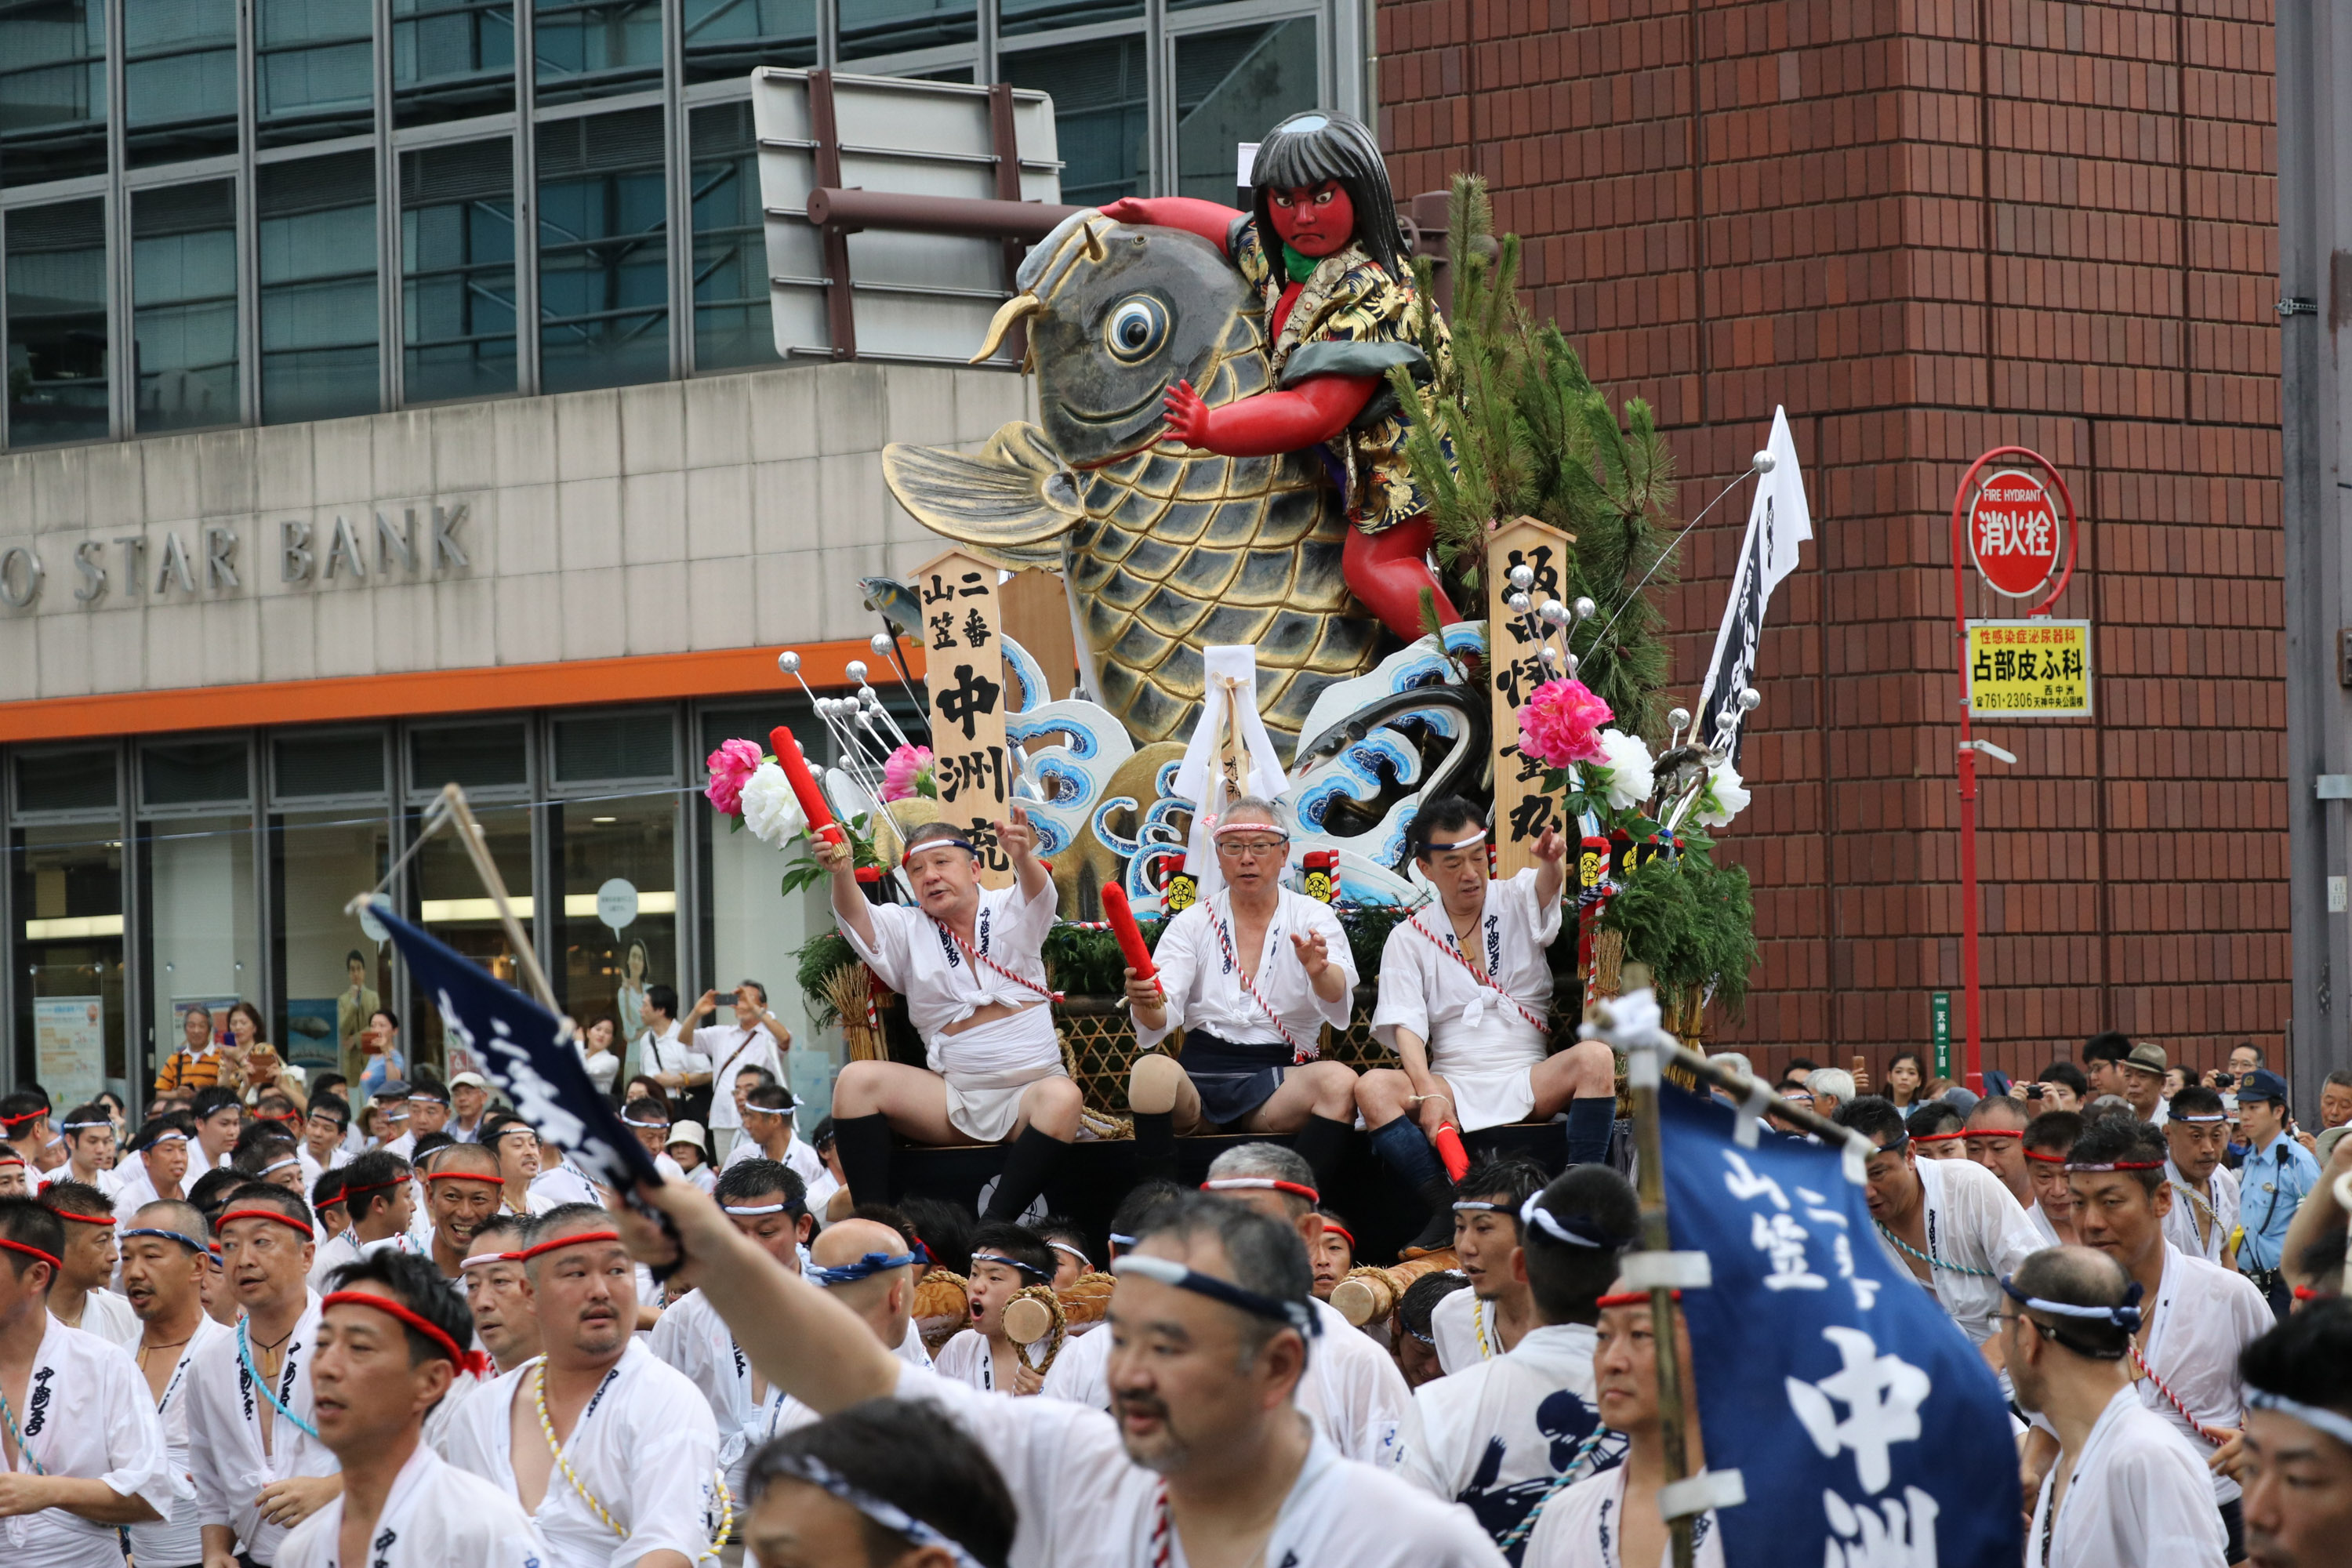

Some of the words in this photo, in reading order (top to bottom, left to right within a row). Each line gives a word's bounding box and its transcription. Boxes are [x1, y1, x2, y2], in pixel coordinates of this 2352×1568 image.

[1983, 488, 2002, 502] FIRE
[2004, 488, 2042, 502] HYDRANT
[73, 527, 241, 601] STAR
[279, 504, 470, 583] BANK
[1978, 510, 2052, 556] 消火栓
[922, 574, 958, 651] 山笠
[958, 572, 992, 648] 二番
[1980, 629, 2076, 644] 性感染症泌尿器科
[1973, 648, 2083, 682] 占部皮ふ科
[2045, 684, 2074, 696] 西中洲
[1937, 1011, 1947, 1068] 天神一丁目
[1722, 1149, 1829, 1290] 山笠
